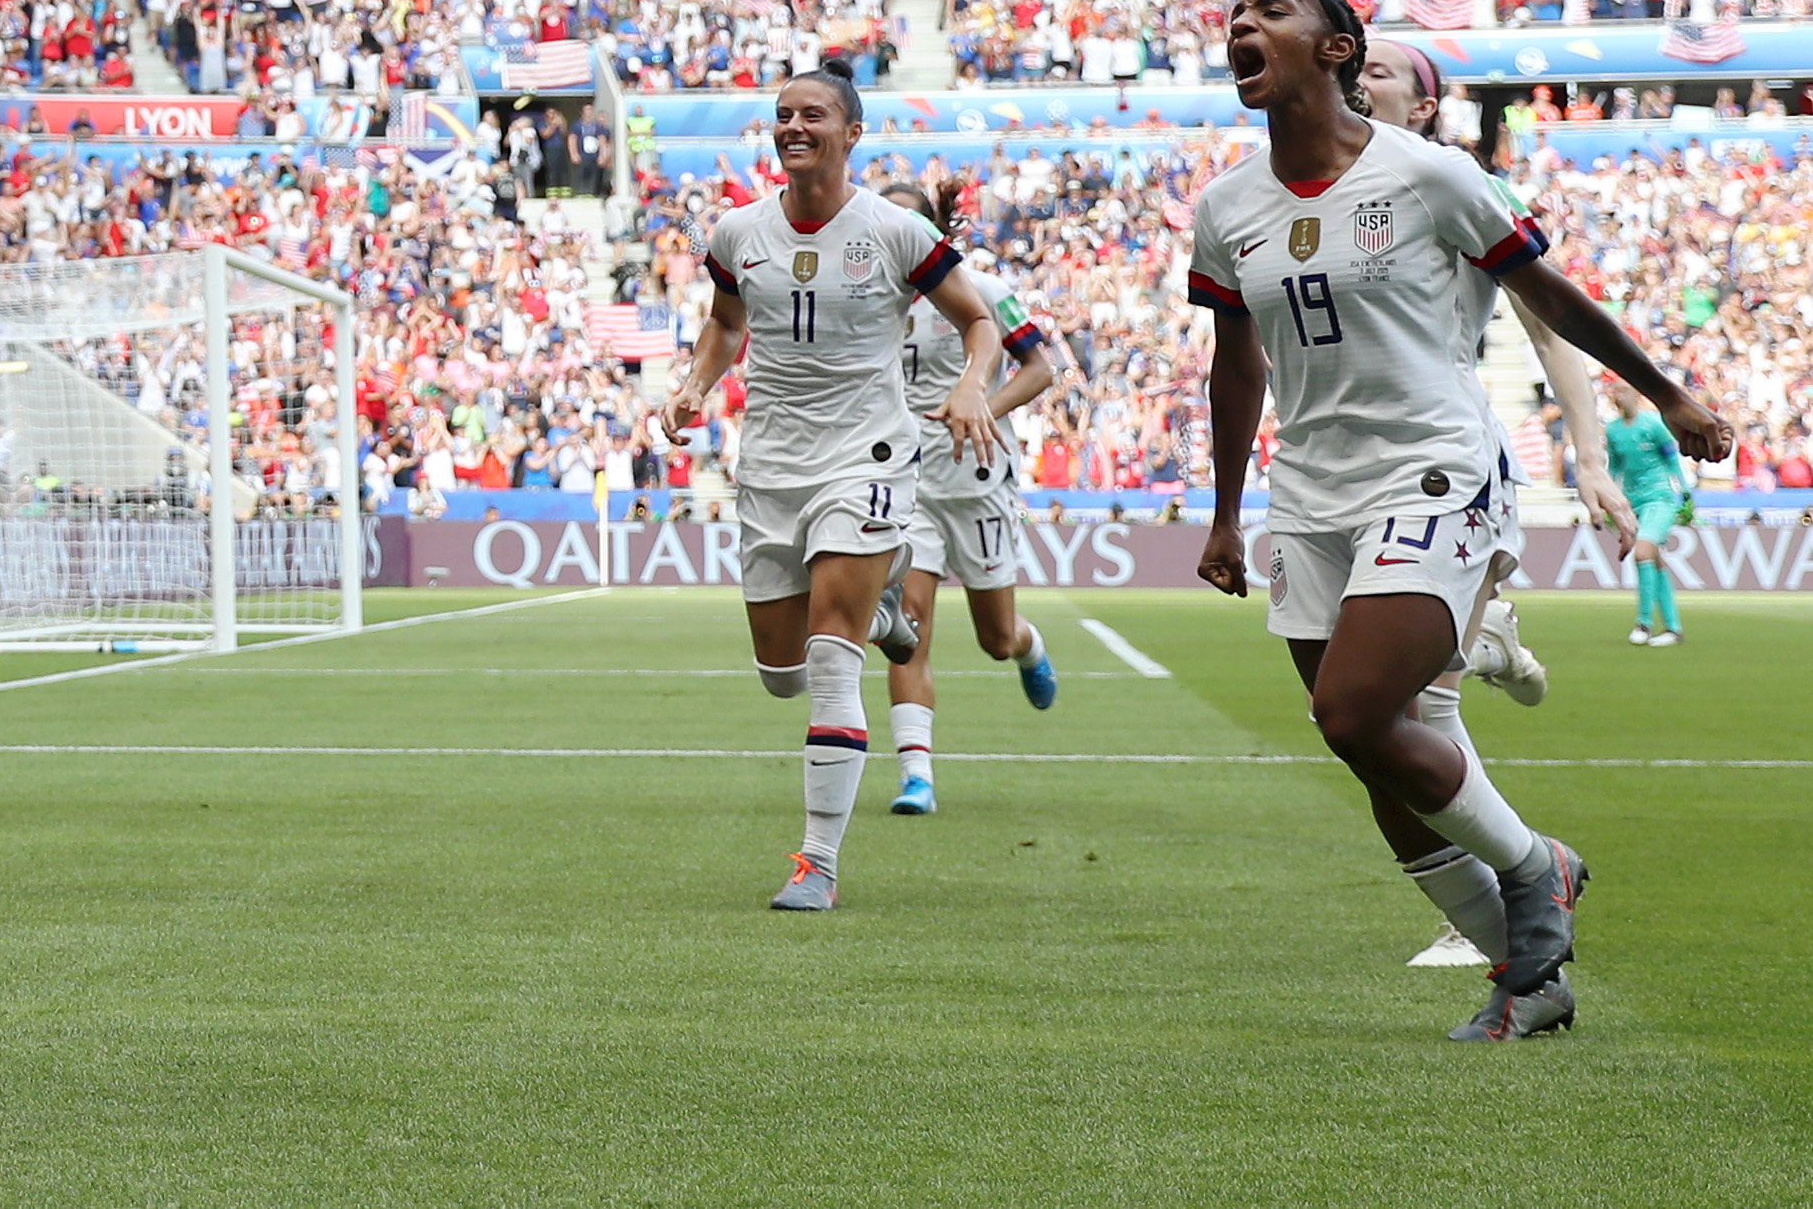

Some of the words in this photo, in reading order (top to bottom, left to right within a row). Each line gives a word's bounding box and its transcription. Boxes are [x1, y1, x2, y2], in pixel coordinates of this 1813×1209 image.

[124, 106, 212, 139] LYON
[1358, 214, 1389, 231] USA
[846, 251, 869, 263] USA
[791, 290, 815, 342] 11
[1281, 272, 1343, 347] 19
[868, 483, 891, 519] 11
[975, 516, 1001, 558] 17
